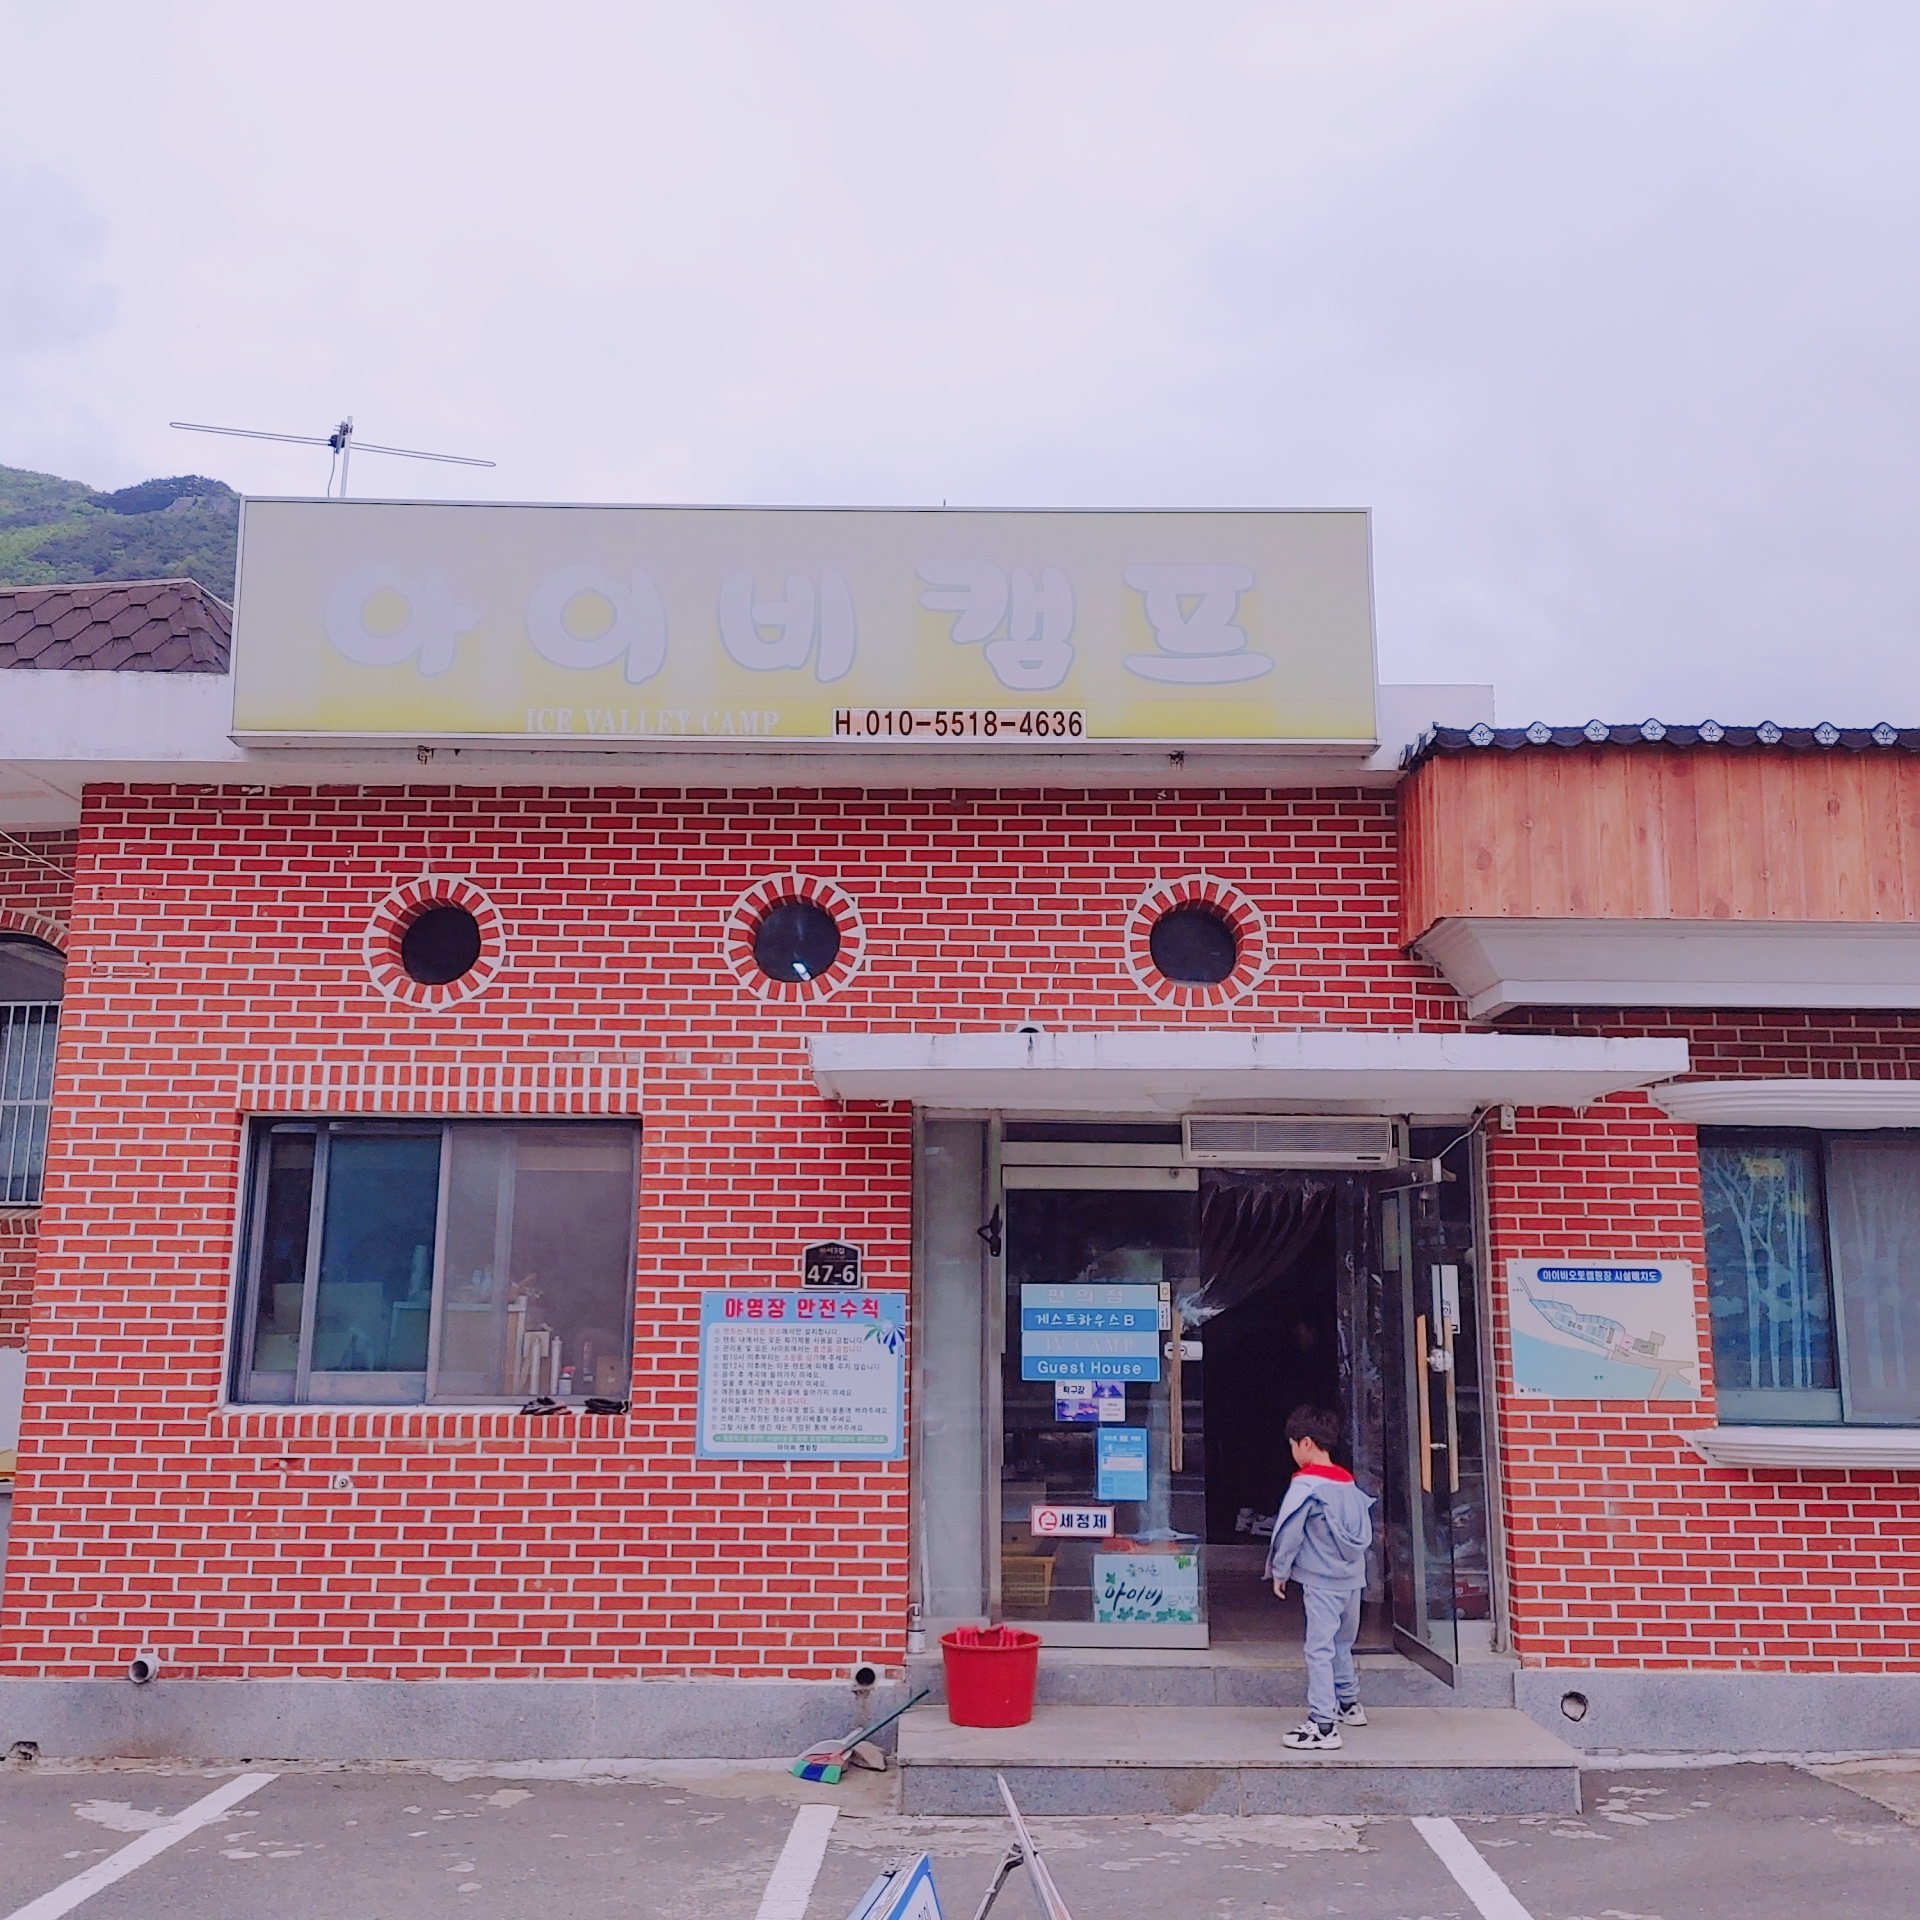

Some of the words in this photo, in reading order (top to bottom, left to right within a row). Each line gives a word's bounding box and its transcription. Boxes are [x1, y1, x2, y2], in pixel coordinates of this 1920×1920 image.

[526, 708, 573, 733] ICE
[583, 709, 691, 734] VALLEY
[702, 710, 780, 735] CAMP
[835, 710, 1084, 736] H.010-5518-4636
[807, 1265, 855, 1283] 47-6
[1047, 1288, 1123, 1304] 편의점
[725, 1298, 786, 1319] 야영장
[797, 1298, 879, 1319] 안전수칙
[1035, 1313, 1135, 1327] 게스트하우스B
[1075, 1338, 1135, 1352] CAMP
[1037, 1361, 1086, 1374] Guest
[1091, 1361, 1142, 1374] House
[1063, 1385, 1085, 1395] 탁구장
[1104, 1582, 1163, 1611] 아이비
